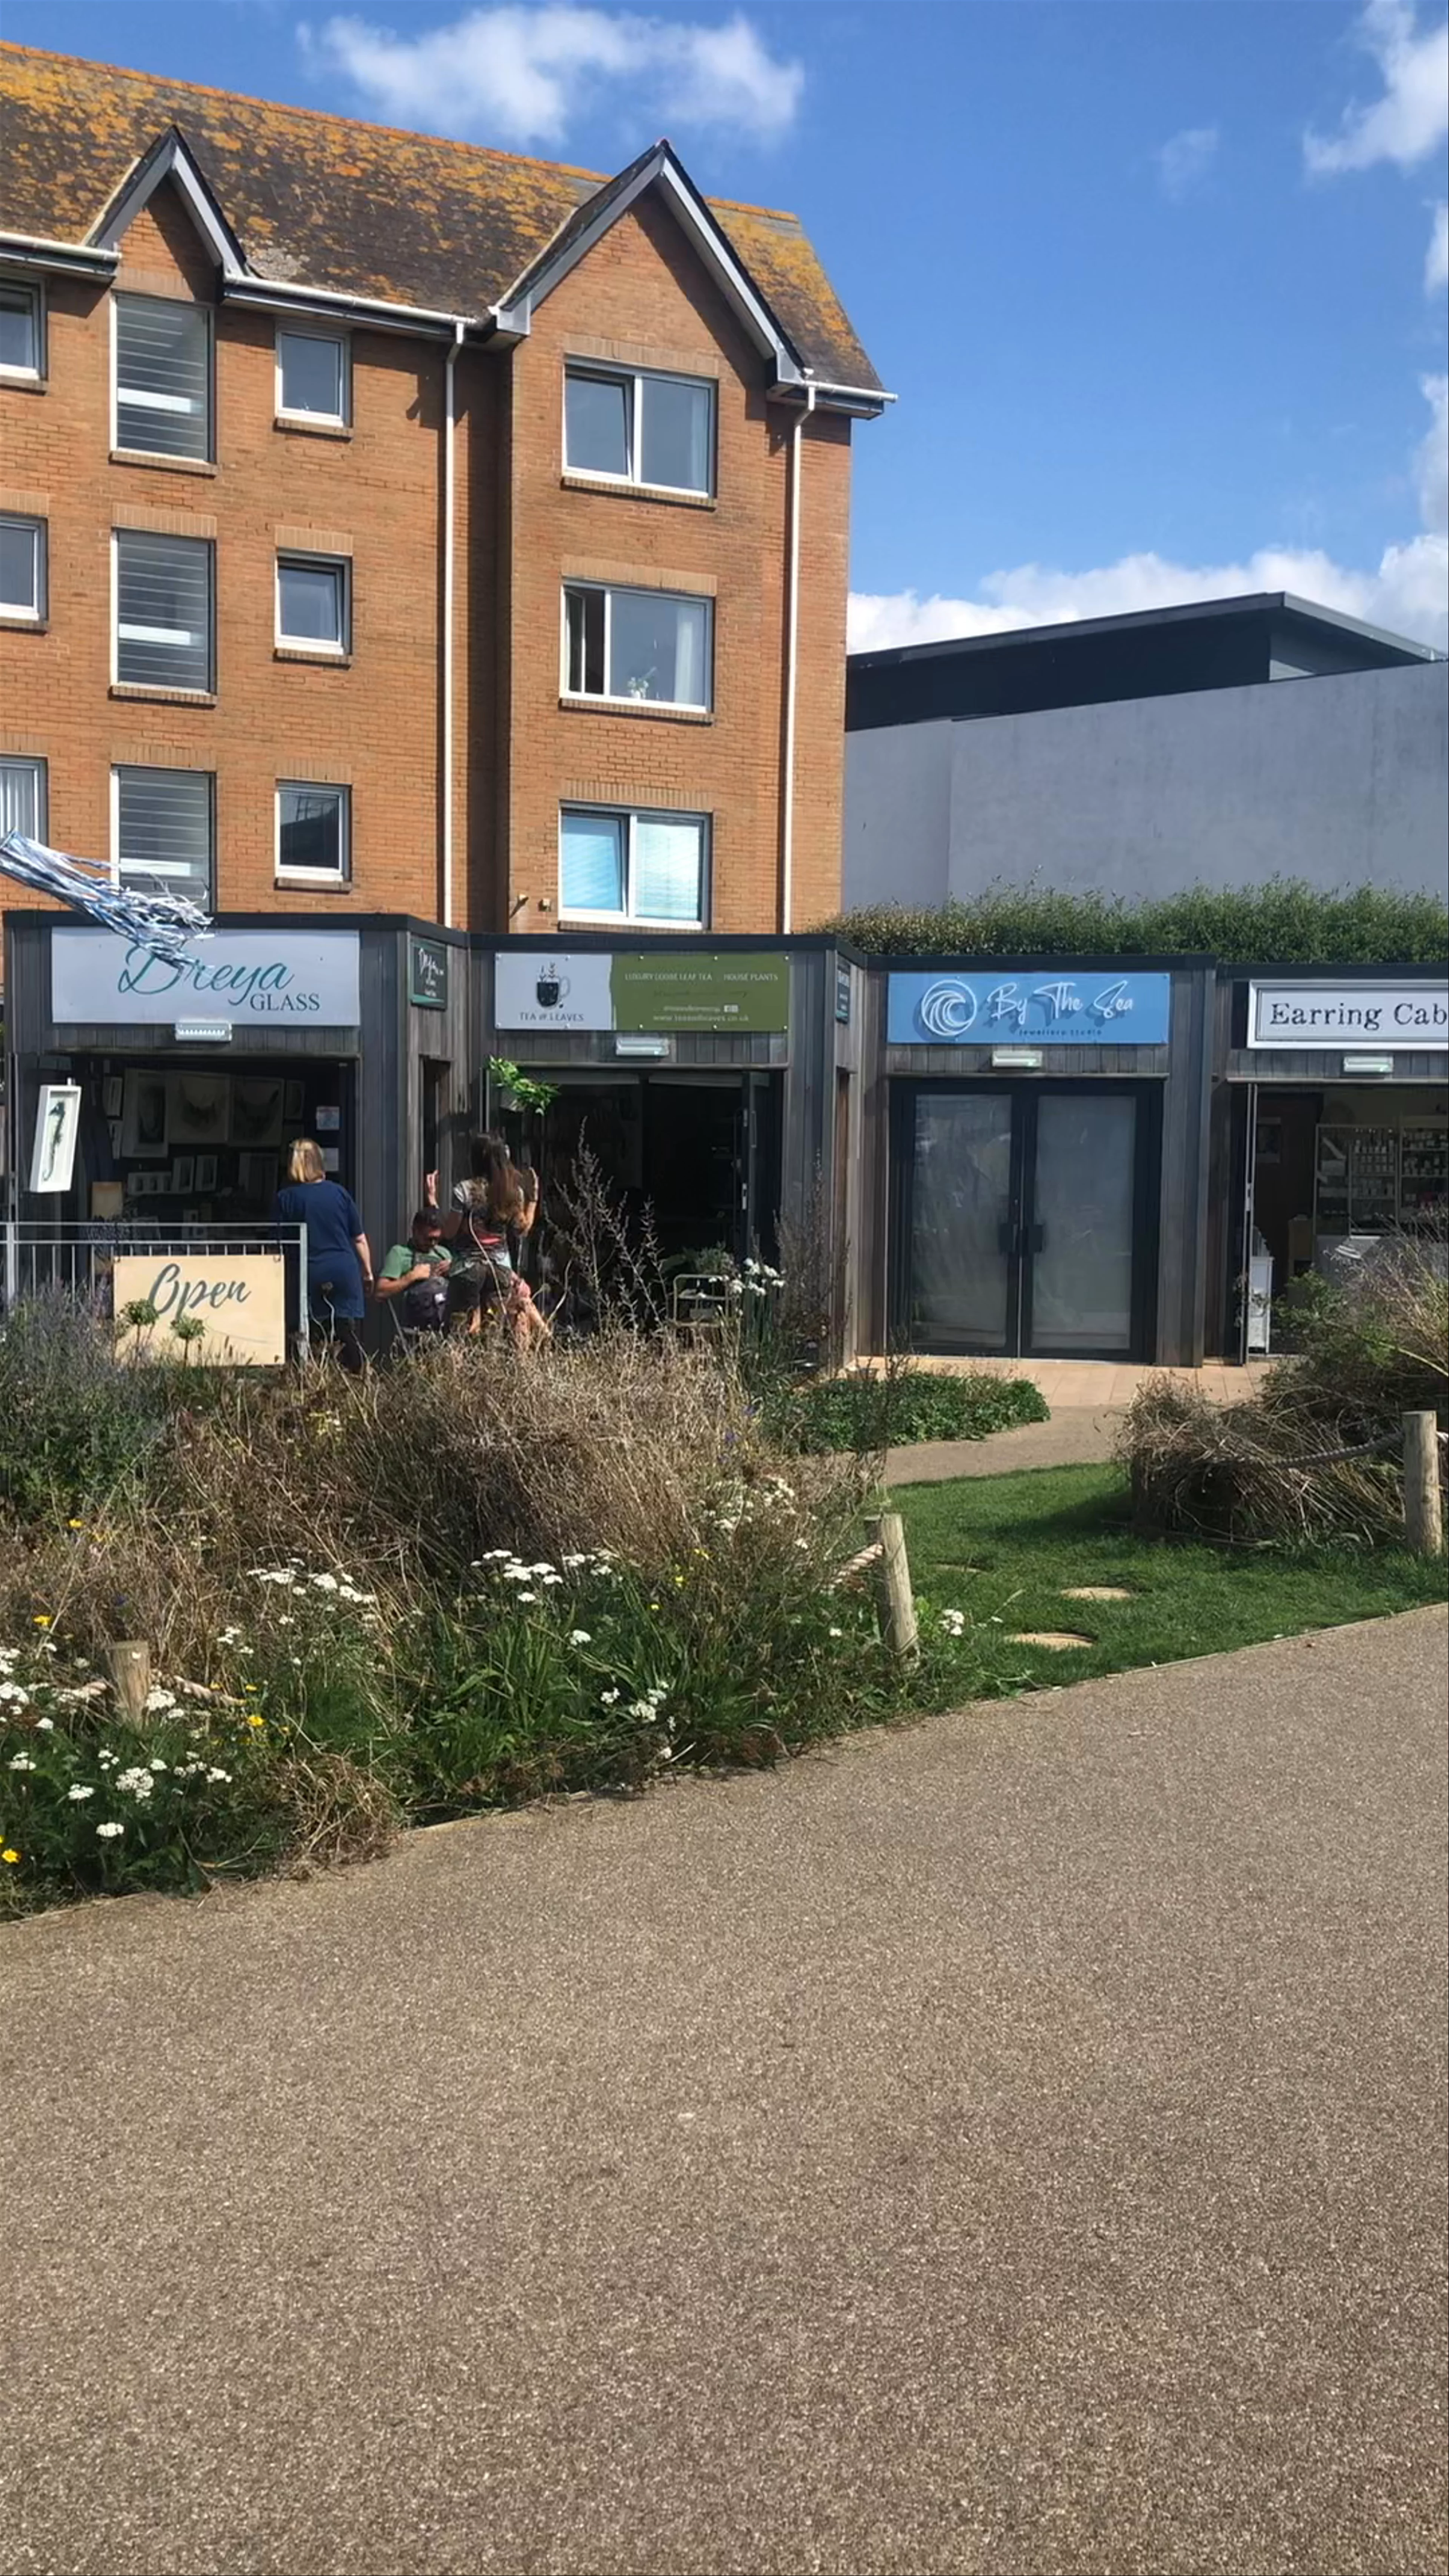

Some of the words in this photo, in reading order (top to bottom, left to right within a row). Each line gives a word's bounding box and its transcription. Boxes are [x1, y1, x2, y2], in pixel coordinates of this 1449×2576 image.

[118, 943, 294, 1006] Dreya
[250, 993, 320, 1011] GLASS
[520, 1012, 537, 1021] TEA
[549, 1012, 584, 1021] LEAVES
[987, 982, 1028, 1025] By
[1033, 981, 1083, 1019] The
[1094, 980, 1133, 1019] Sea
[1269, 1002, 1382, 1031] Earring
[148, 1263, 251, 1322] Open
